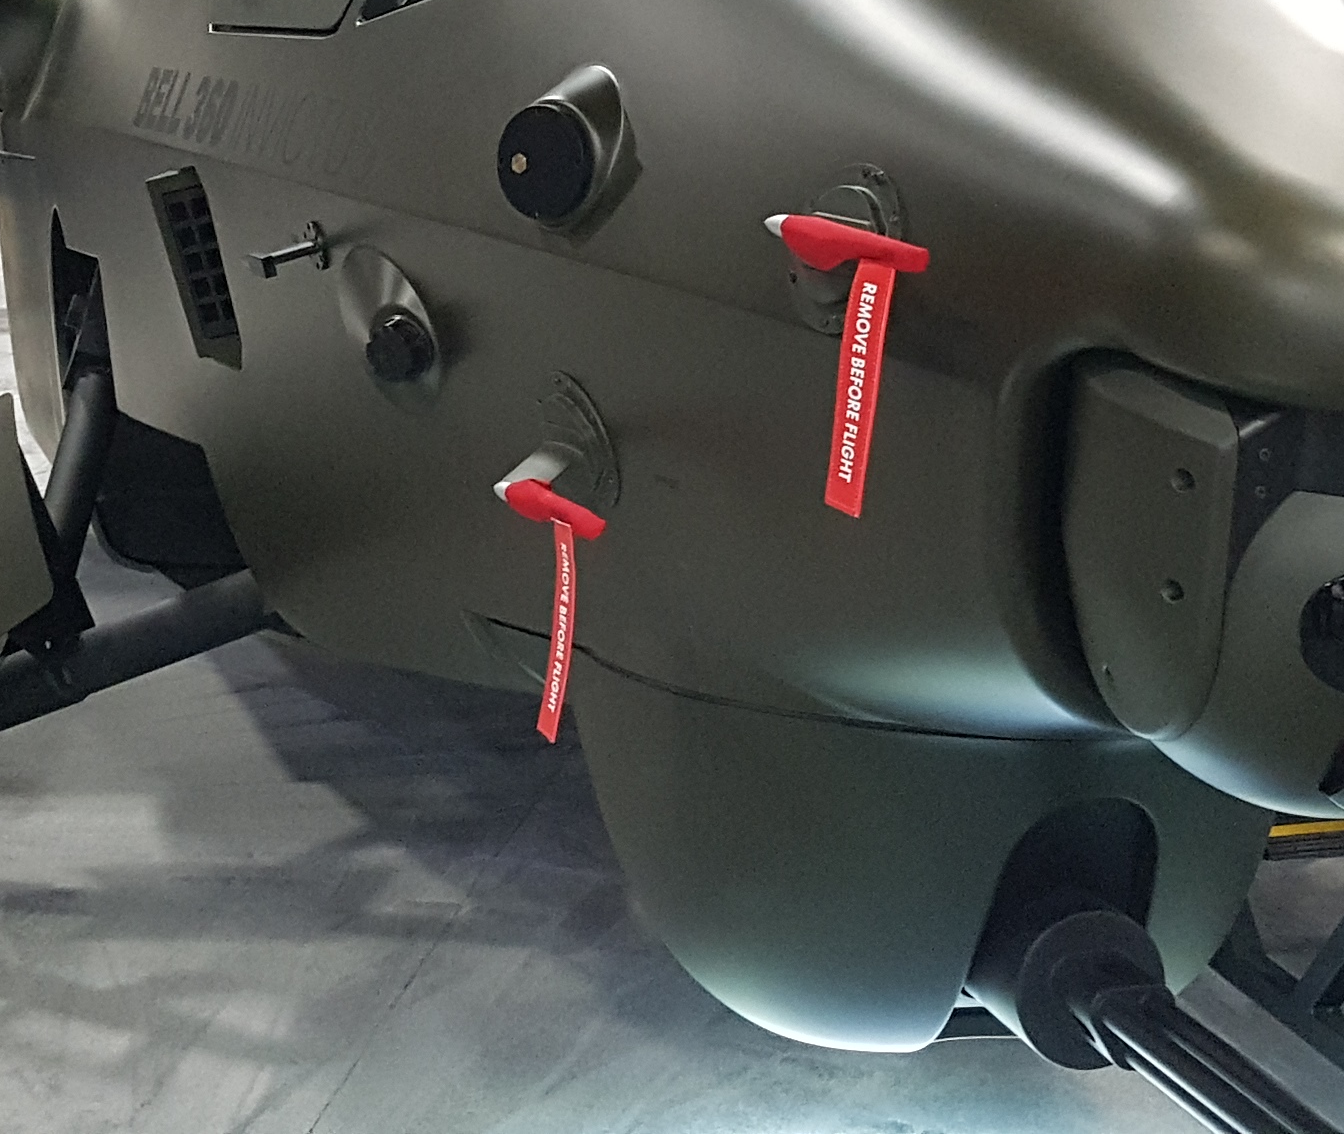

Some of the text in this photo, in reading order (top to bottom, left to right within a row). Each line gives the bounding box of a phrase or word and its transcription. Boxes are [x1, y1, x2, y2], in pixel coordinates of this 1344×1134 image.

[133, 66, 192, 134] BELL
[181, 75, 239, 146] 360
[838, 281, 878, 483] REMOVE BEFORE FLIGHT
[547, 542, 570, 714] REMOVE BEFORE FLIGHT
